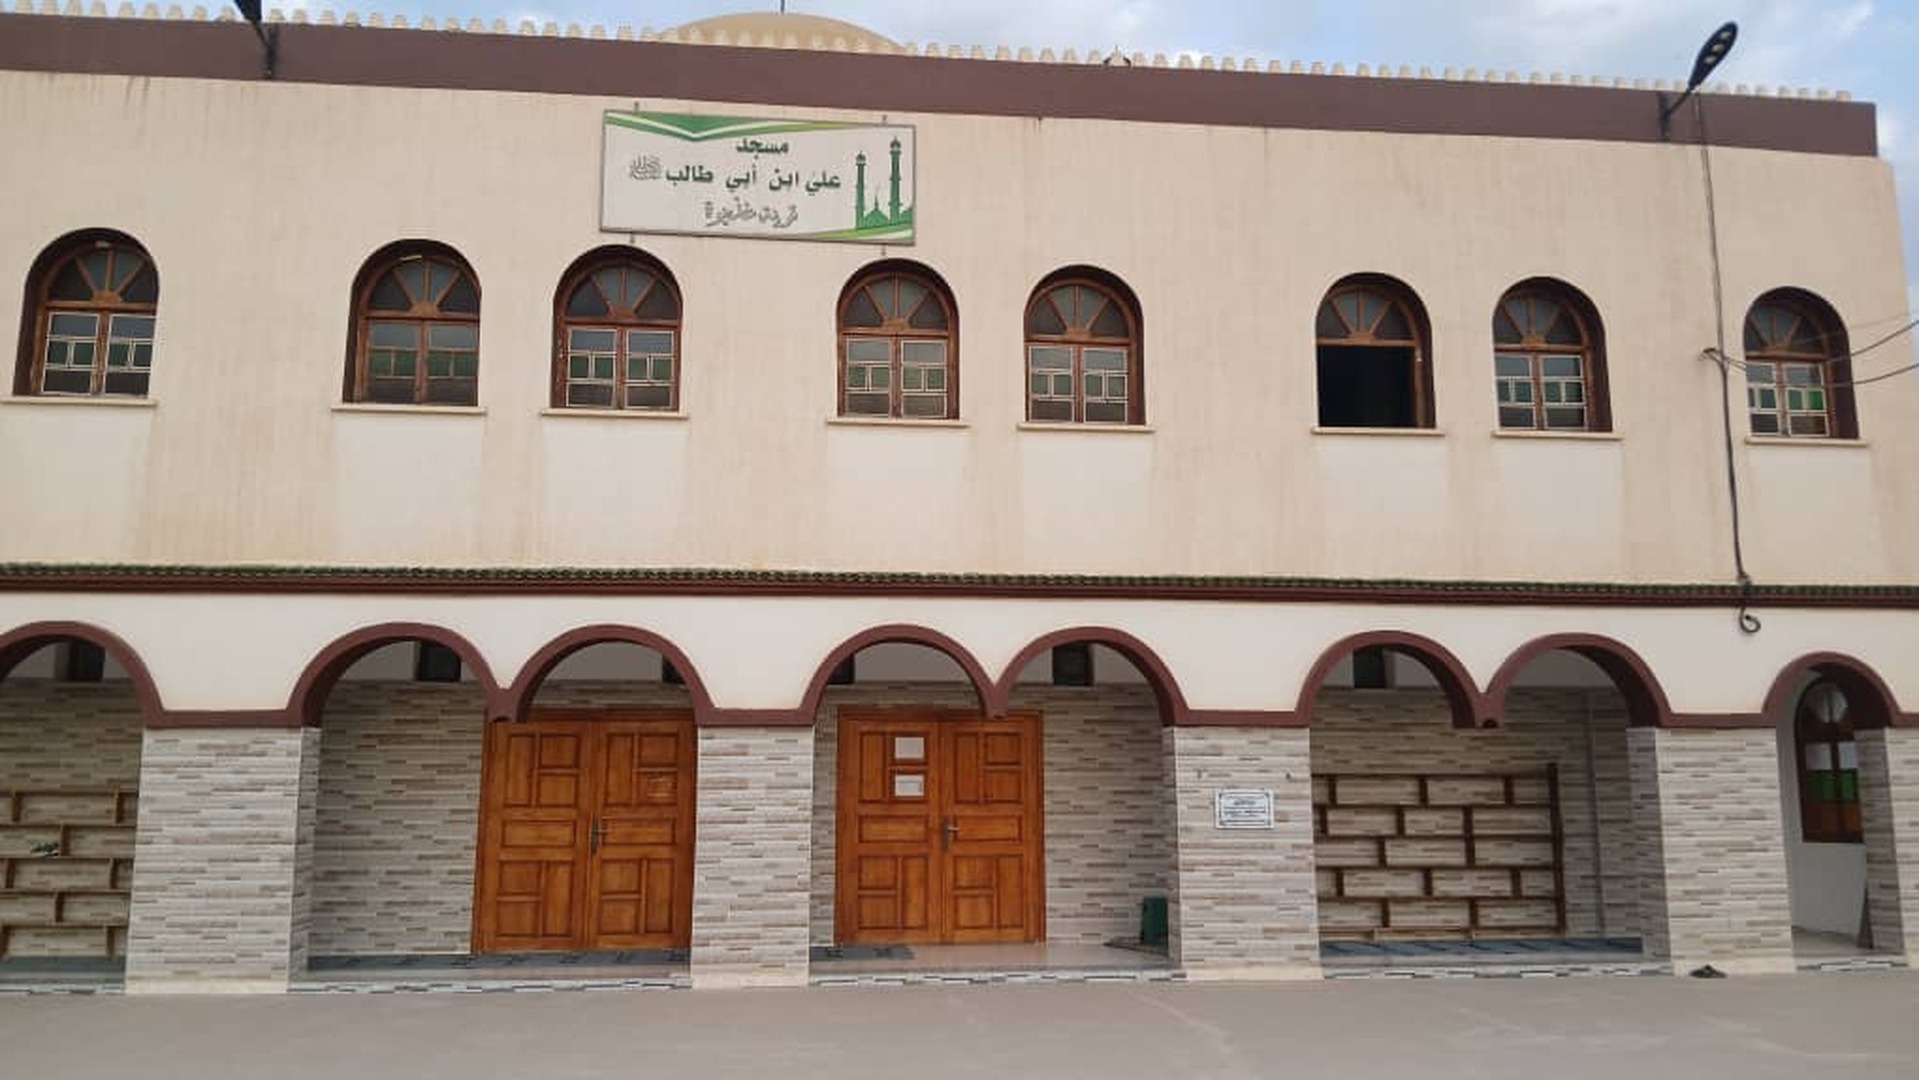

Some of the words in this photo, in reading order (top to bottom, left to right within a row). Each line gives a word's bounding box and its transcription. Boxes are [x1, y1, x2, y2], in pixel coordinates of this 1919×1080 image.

[735, 138, 789, 159] مسجد
[665, 165, 714, 186] طالب
[725, 164, 757, 193] أبي
[768, 168, 799, 191] ابن
[805, 170, 842, 196] علي
